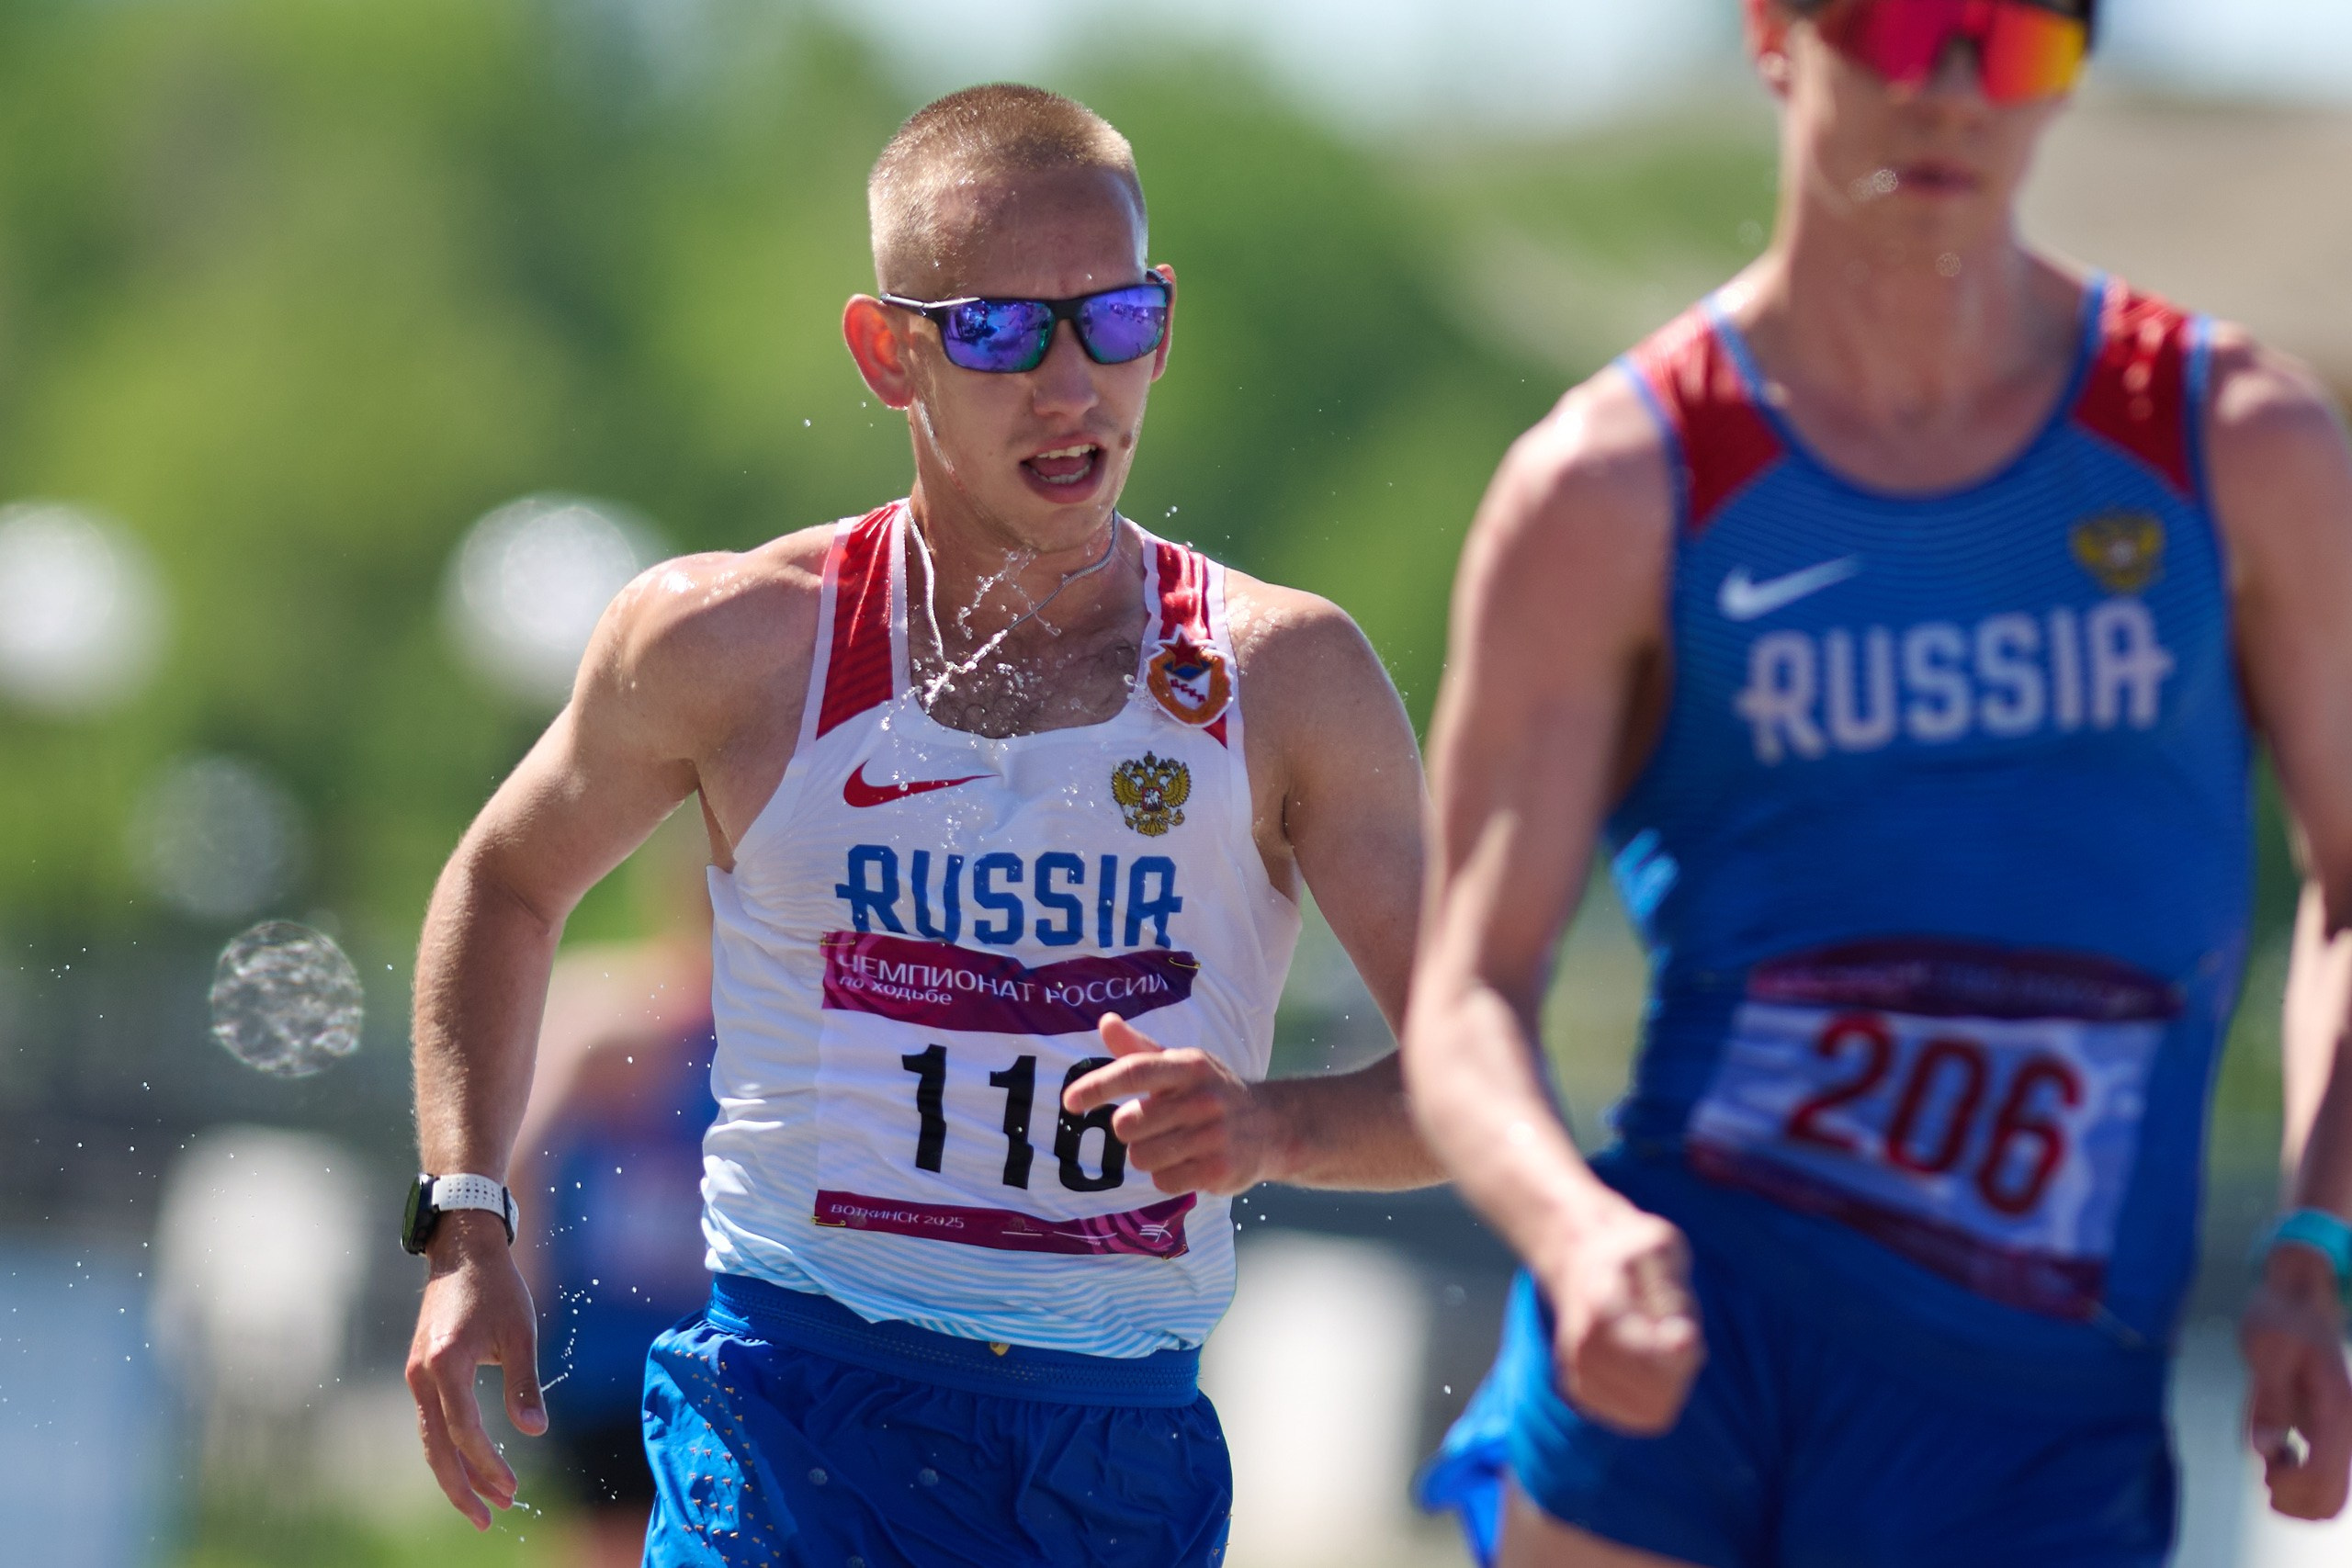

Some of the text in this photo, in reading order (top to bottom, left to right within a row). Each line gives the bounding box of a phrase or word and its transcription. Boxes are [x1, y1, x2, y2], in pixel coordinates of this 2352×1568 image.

[1735, 598, 2174, 764] RUSSIA
[835, 843, 1183, 949] RUSSIA
[837, 953, 1035, 1002] ЧЕМПИОНАТ
[840, 976, 953, 1005] по ходьбе
[901, 1043, 1127, 1192] 116
[1784, 1011, 2084, 1218] 206
[831, 1203, 965, 1229] ВОТКИНСК 2025
